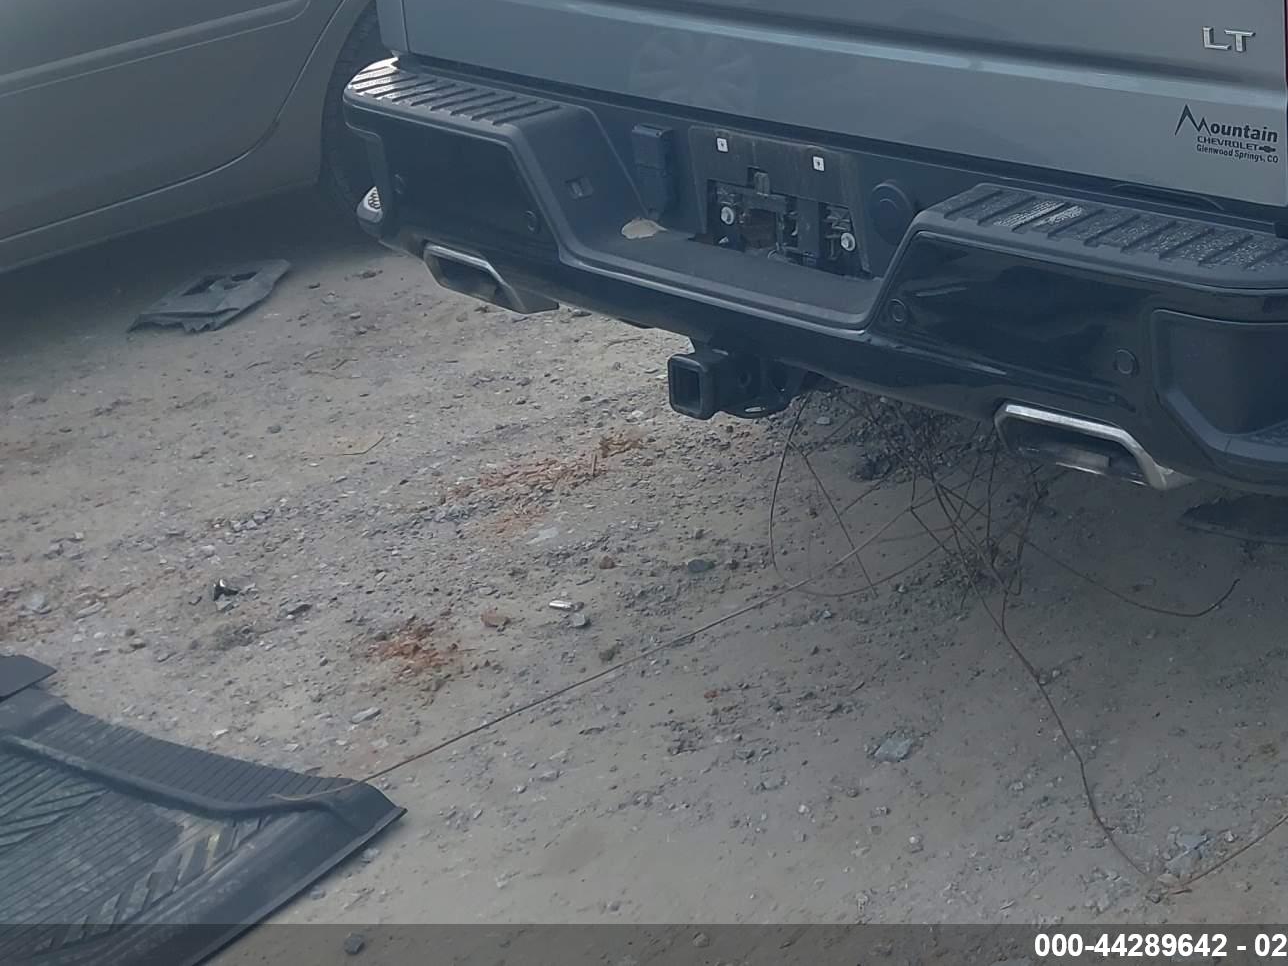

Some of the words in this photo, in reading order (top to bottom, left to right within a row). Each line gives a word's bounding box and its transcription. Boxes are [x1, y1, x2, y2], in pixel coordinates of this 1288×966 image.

[1202, 26, 1256, 53] LT
[1174, 104, 1278, 142] Mountain
[1196, 143, 1233, 157] Glenwood
[1234, 149, 1266, 163] Springs,
[1267, 154, 1279, 164] CO
[1197, 135, 1259, 151] CHEVROLET
